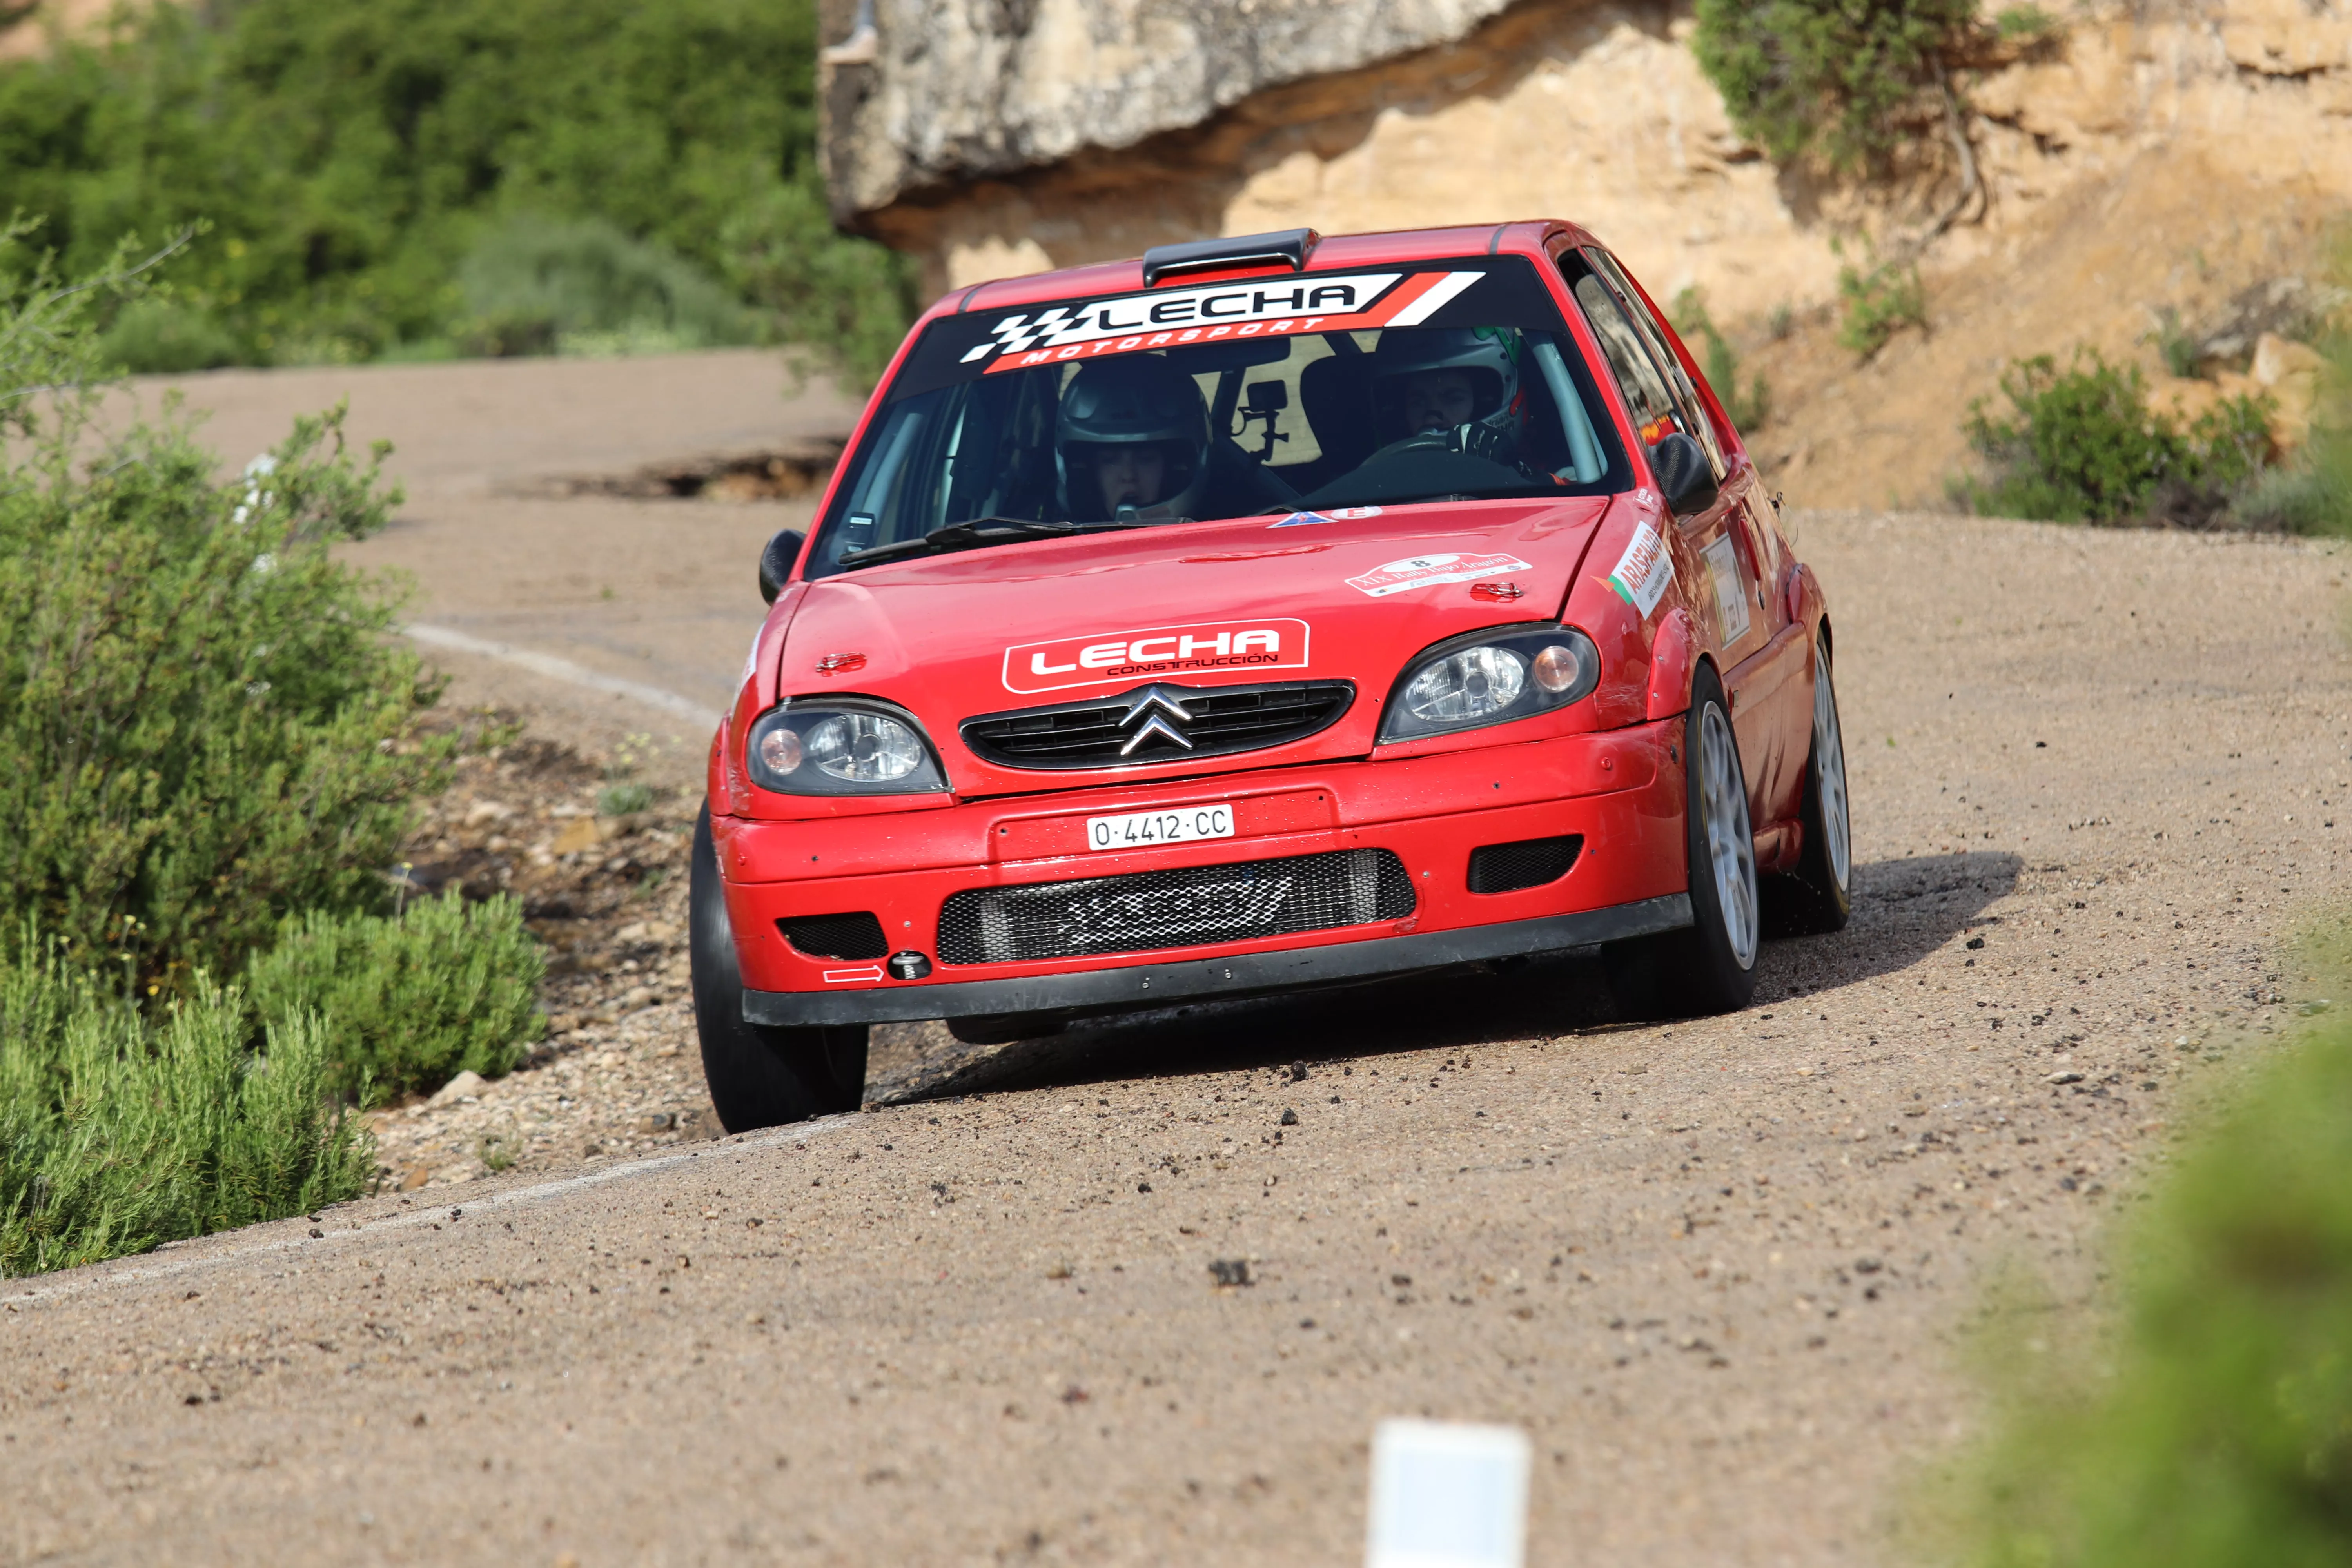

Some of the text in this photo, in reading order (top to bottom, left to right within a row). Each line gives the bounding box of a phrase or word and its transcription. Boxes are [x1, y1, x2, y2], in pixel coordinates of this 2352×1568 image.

[1099, 285, 1356, 330] LECHA
[1020, 318, 1324, 365] MOTORSPORT
[1391, 570, 1428, 579] Rally
[1427, 564, 1460, 573] Bajo
[1620, 529, 1662, 595] ARASFALTO
[1031, 629, 1280, 675] LECHA
[1107, 653, 1279, 676] CONSTRUCCIÓN
